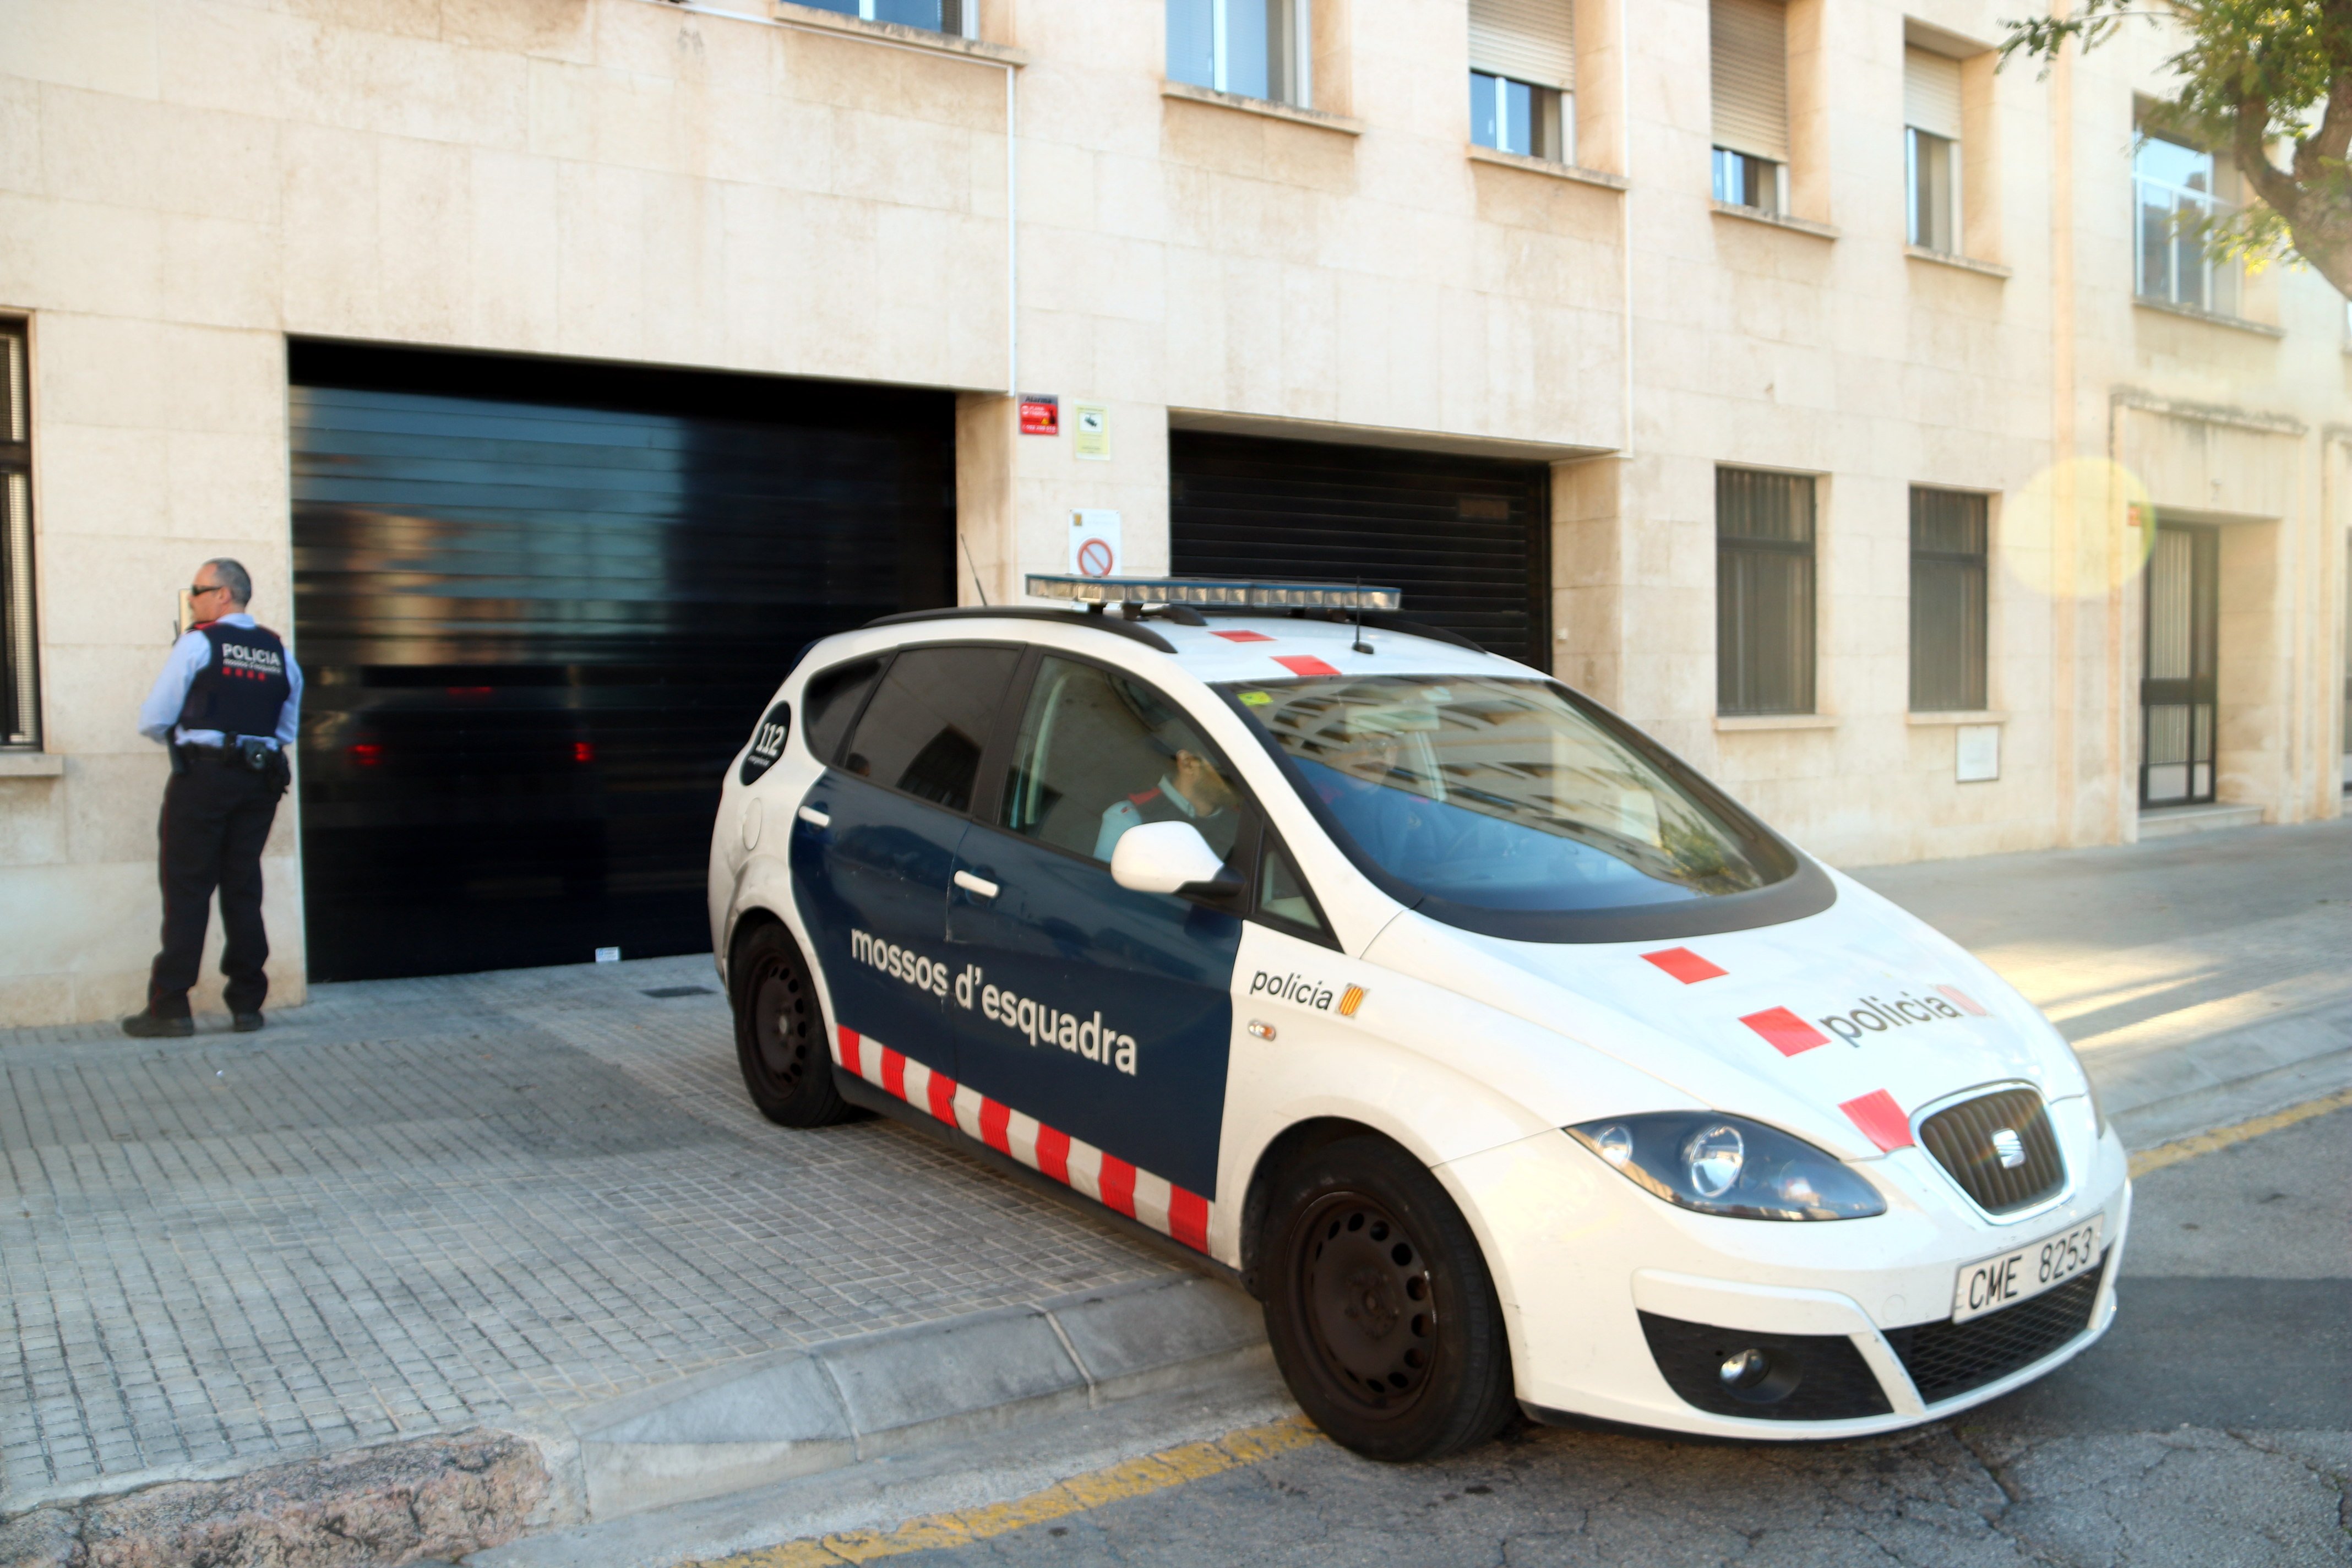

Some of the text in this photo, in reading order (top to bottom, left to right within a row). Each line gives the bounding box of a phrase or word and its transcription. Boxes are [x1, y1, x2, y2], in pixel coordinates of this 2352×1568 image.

[222, 643, 281, 667] POLICIA
[755, 722, 786, 756] 112
[851, 928, 1138, 1076] mossos d'esquadra
[1249, 970, 1333, 1010] policia
[1818, 991, 1964, 1048] policia
[1968, 1225, 2093, 1310] CME 8253
